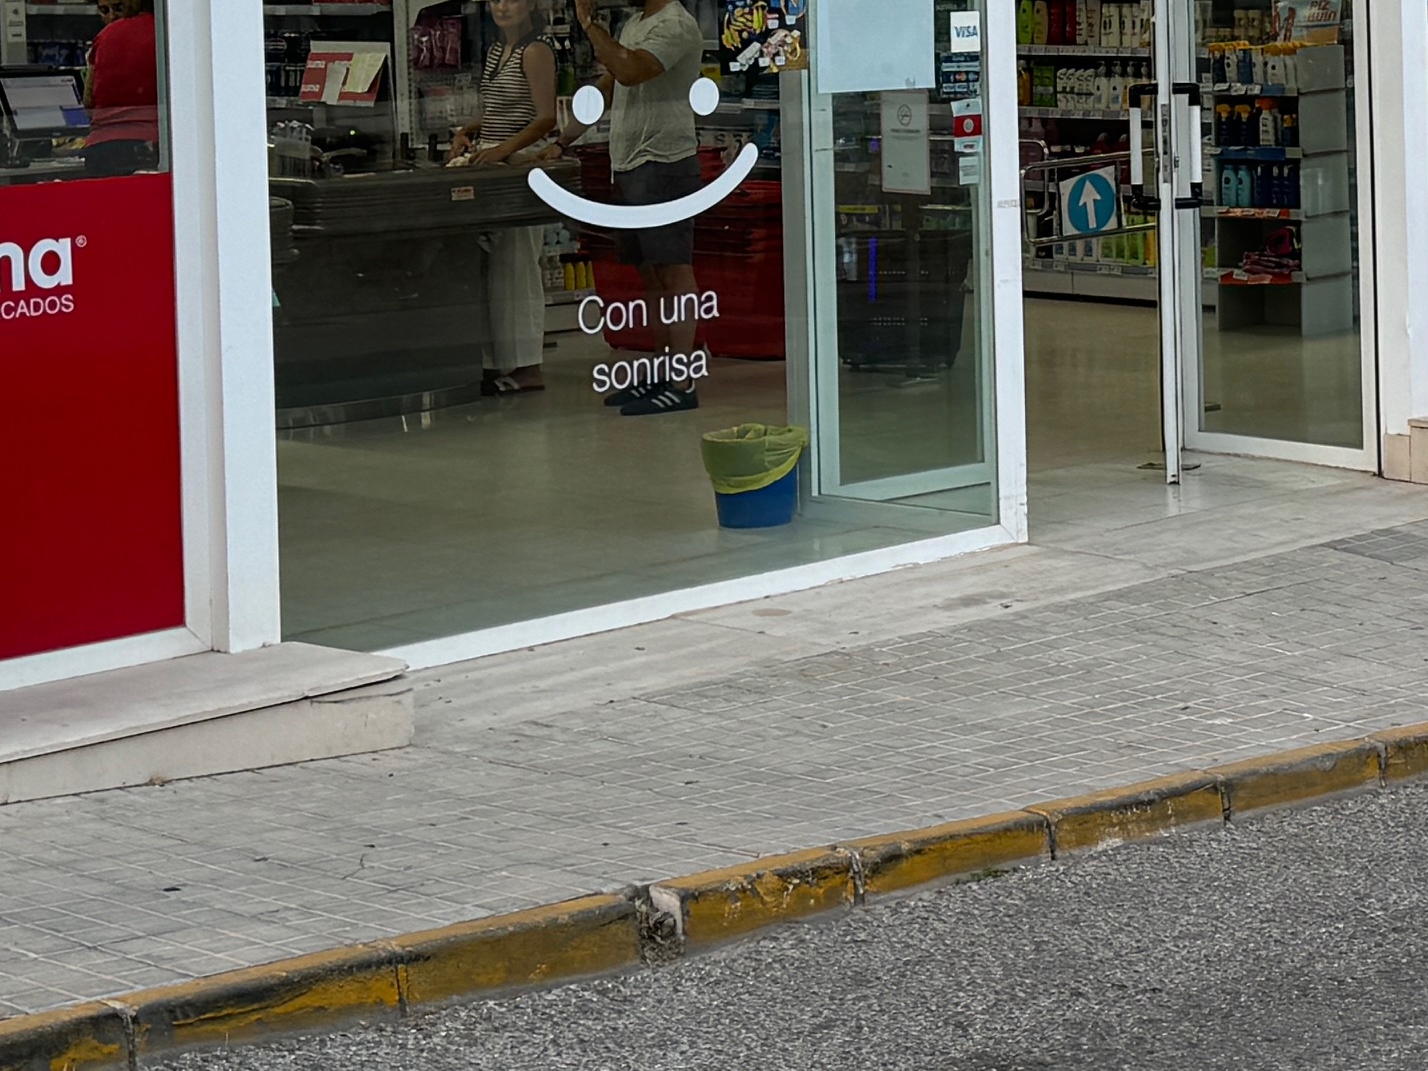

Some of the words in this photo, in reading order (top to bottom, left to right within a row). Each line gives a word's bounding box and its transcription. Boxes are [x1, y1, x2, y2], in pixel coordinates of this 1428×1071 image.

[954, 26, 978, 38] VISA
[578, 295, 648, 334] Con
[659, 290, 720, 324] una
[592, 346, 709, 393] sonrisa
